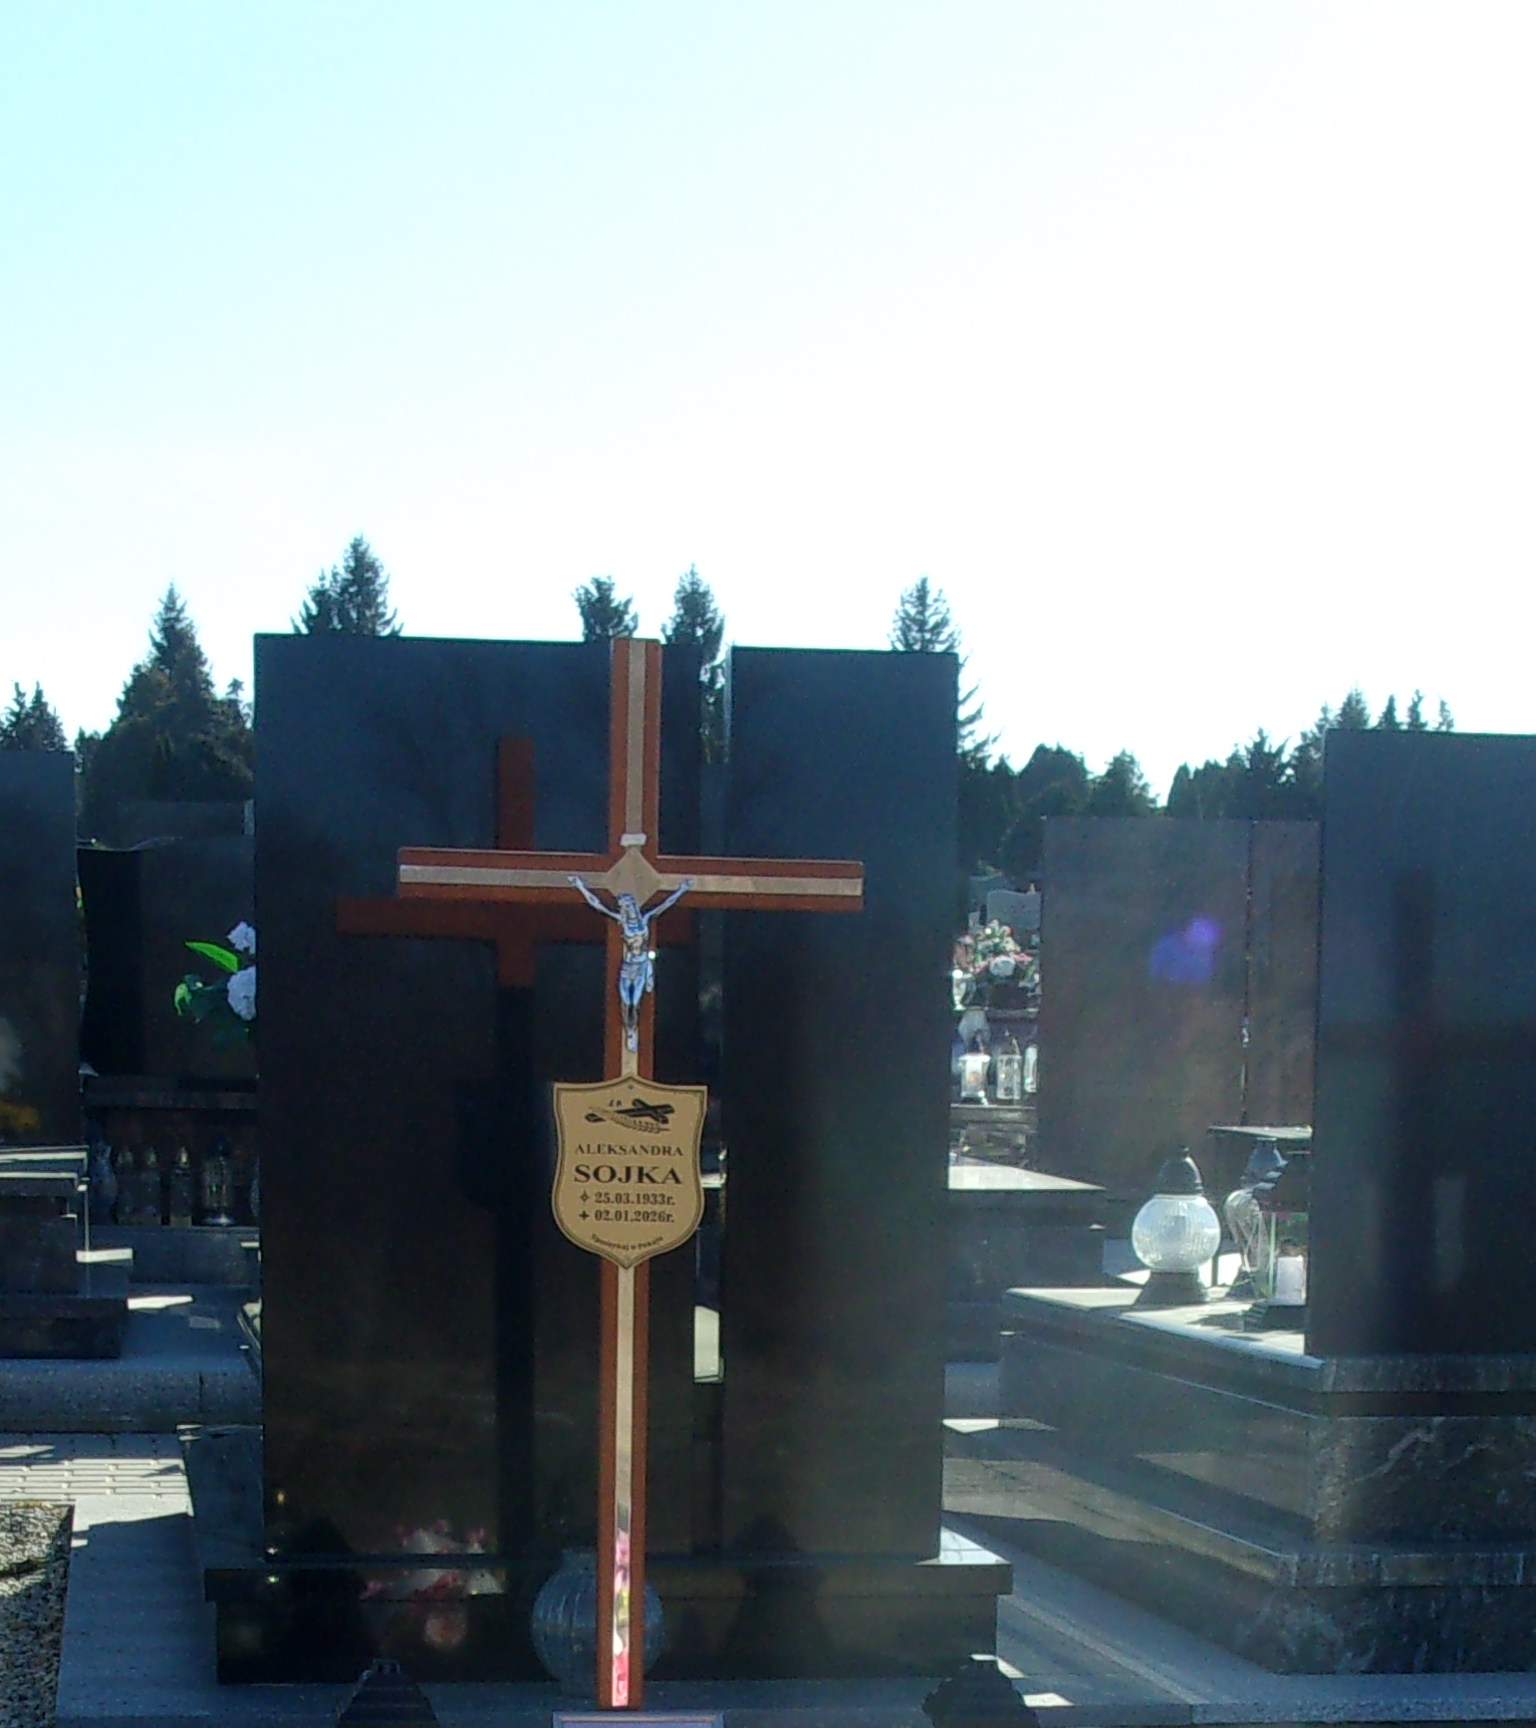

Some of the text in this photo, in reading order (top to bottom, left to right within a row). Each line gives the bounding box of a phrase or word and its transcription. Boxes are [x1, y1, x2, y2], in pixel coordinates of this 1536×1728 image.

[574, 1143, 684, 1157] ALEKSANDRA
[573, 1164, 682, 1185] SOJKA
[594, 1192, 675, 1206] 25.03.1933r.
[594, 1210, 675, 1224] 02.01.2026r.
